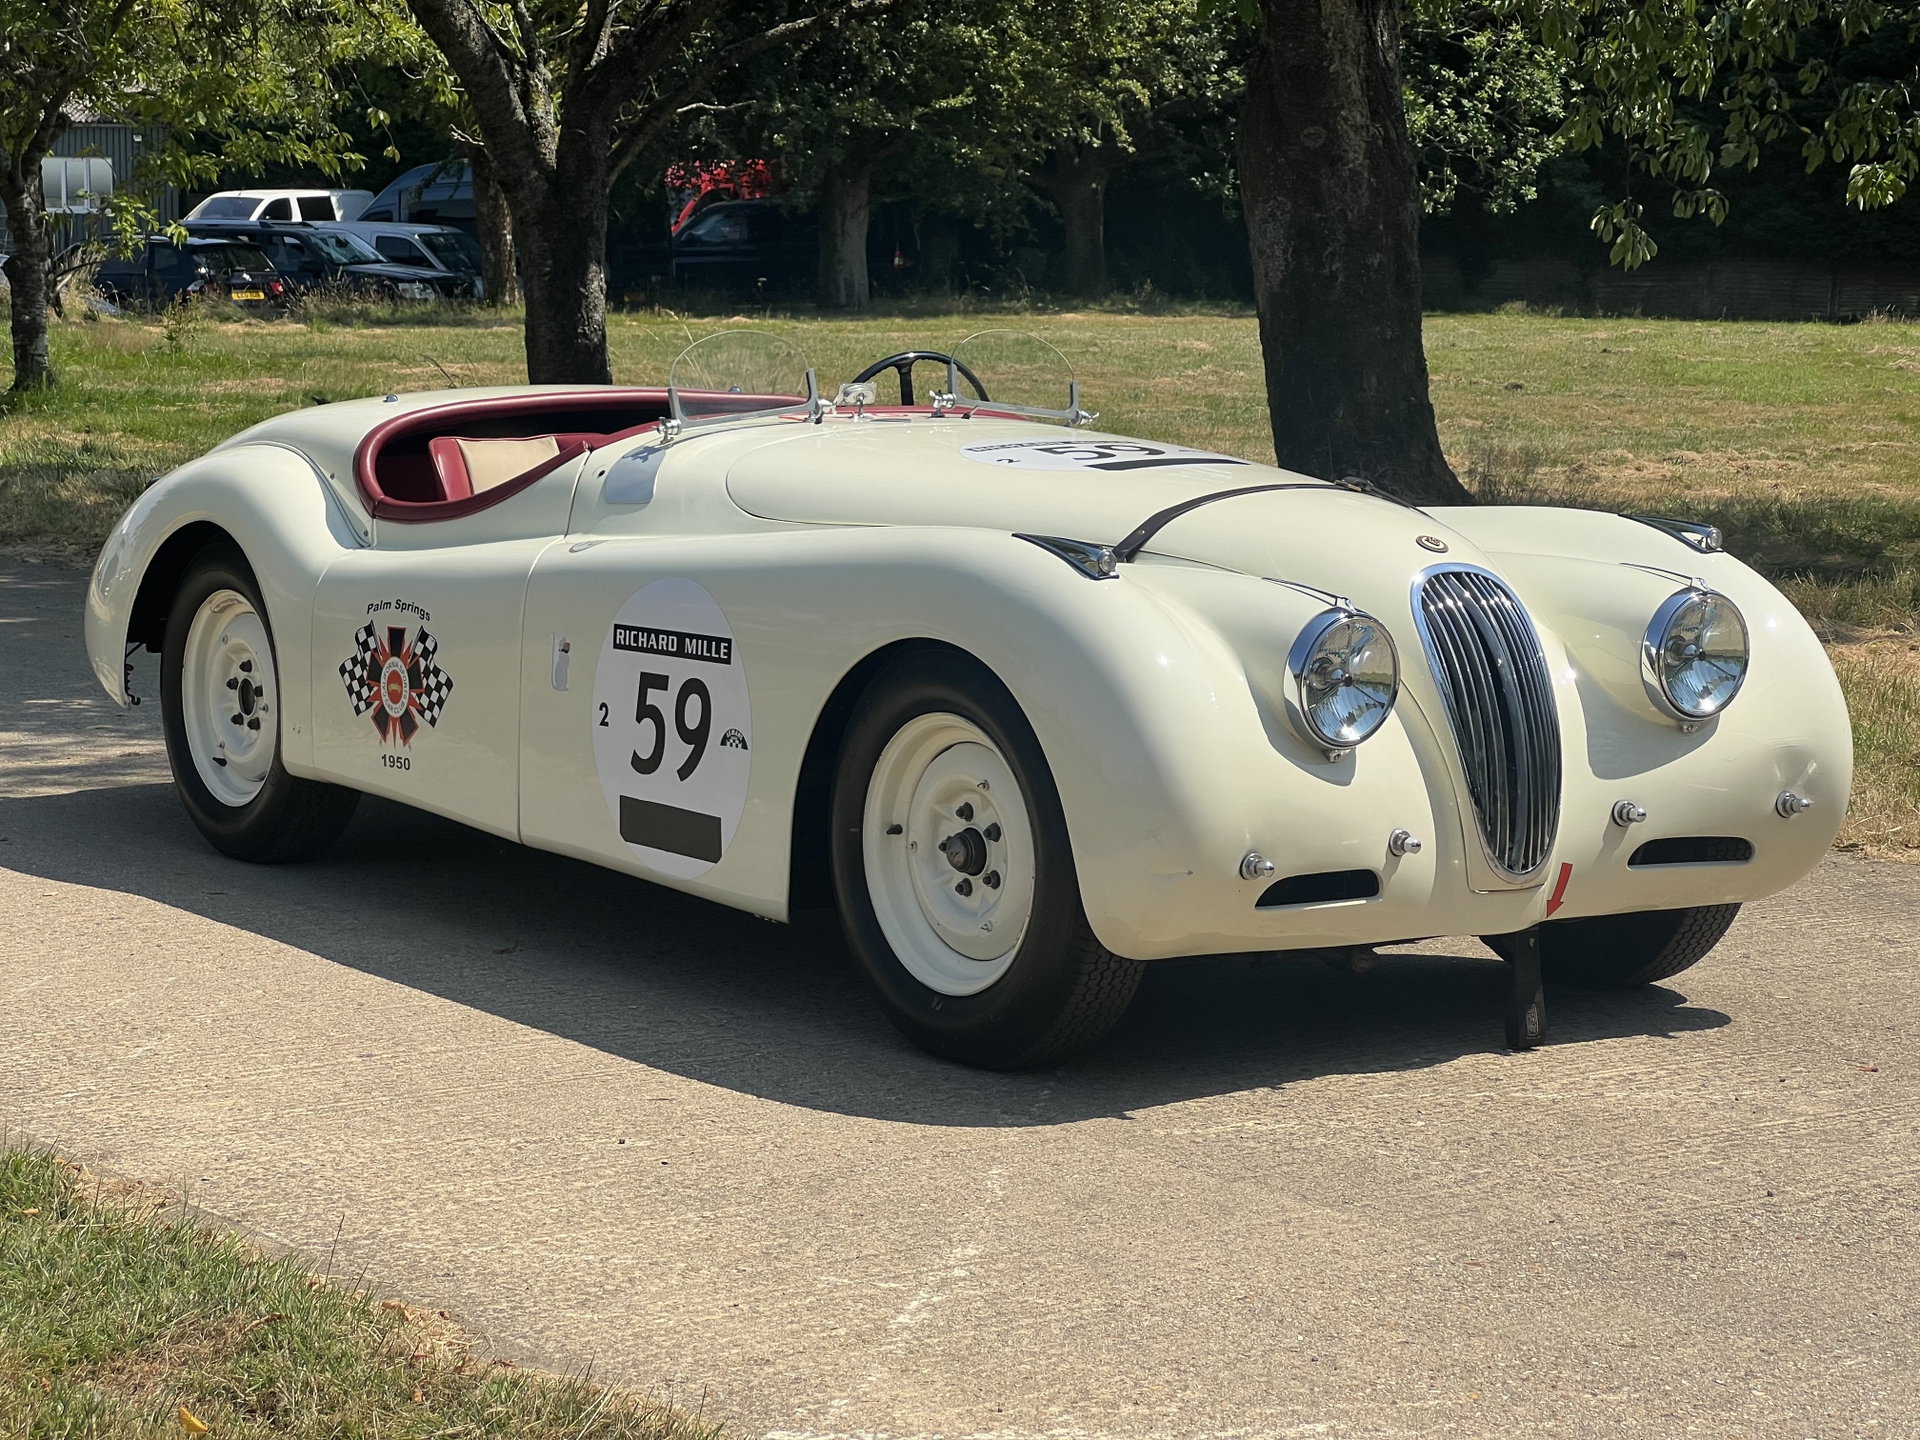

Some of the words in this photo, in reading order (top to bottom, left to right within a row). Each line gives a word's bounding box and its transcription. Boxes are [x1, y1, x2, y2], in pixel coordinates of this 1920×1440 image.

[1033, 444, 1166, 461] 59
[366, 599, 392, 615] Palm
[394, 598, 431, 622] Springs
[615, 628, 678, 652] RICHARD
[684, 637, 729, 660] MILLE
[598, 701, 609, 728] 2
[630, 671, 712, 783] 59
[381, 753, 411, 771] 1950
